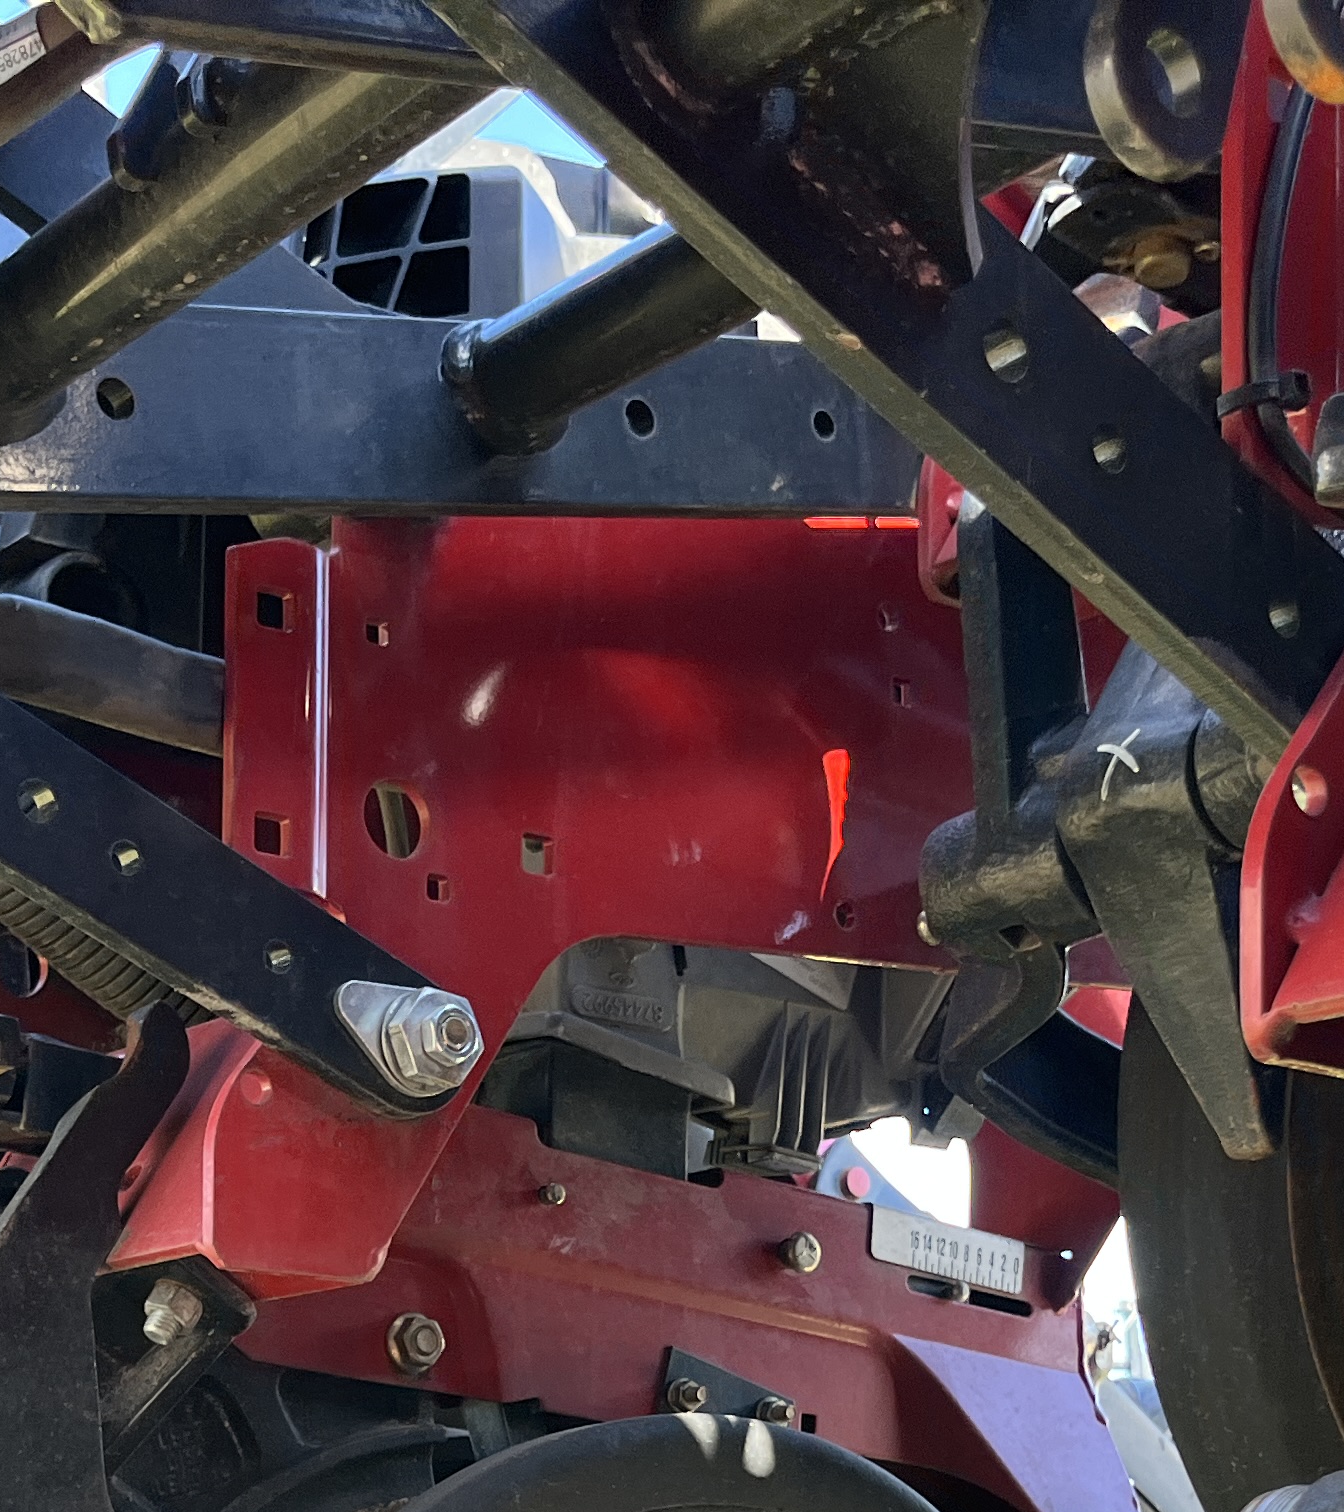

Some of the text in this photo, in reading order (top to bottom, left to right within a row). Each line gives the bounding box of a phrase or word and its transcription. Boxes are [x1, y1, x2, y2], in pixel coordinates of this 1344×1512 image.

[910, 1230, 1019, 1275] 16 14 12 10 8 6 4 2 0
